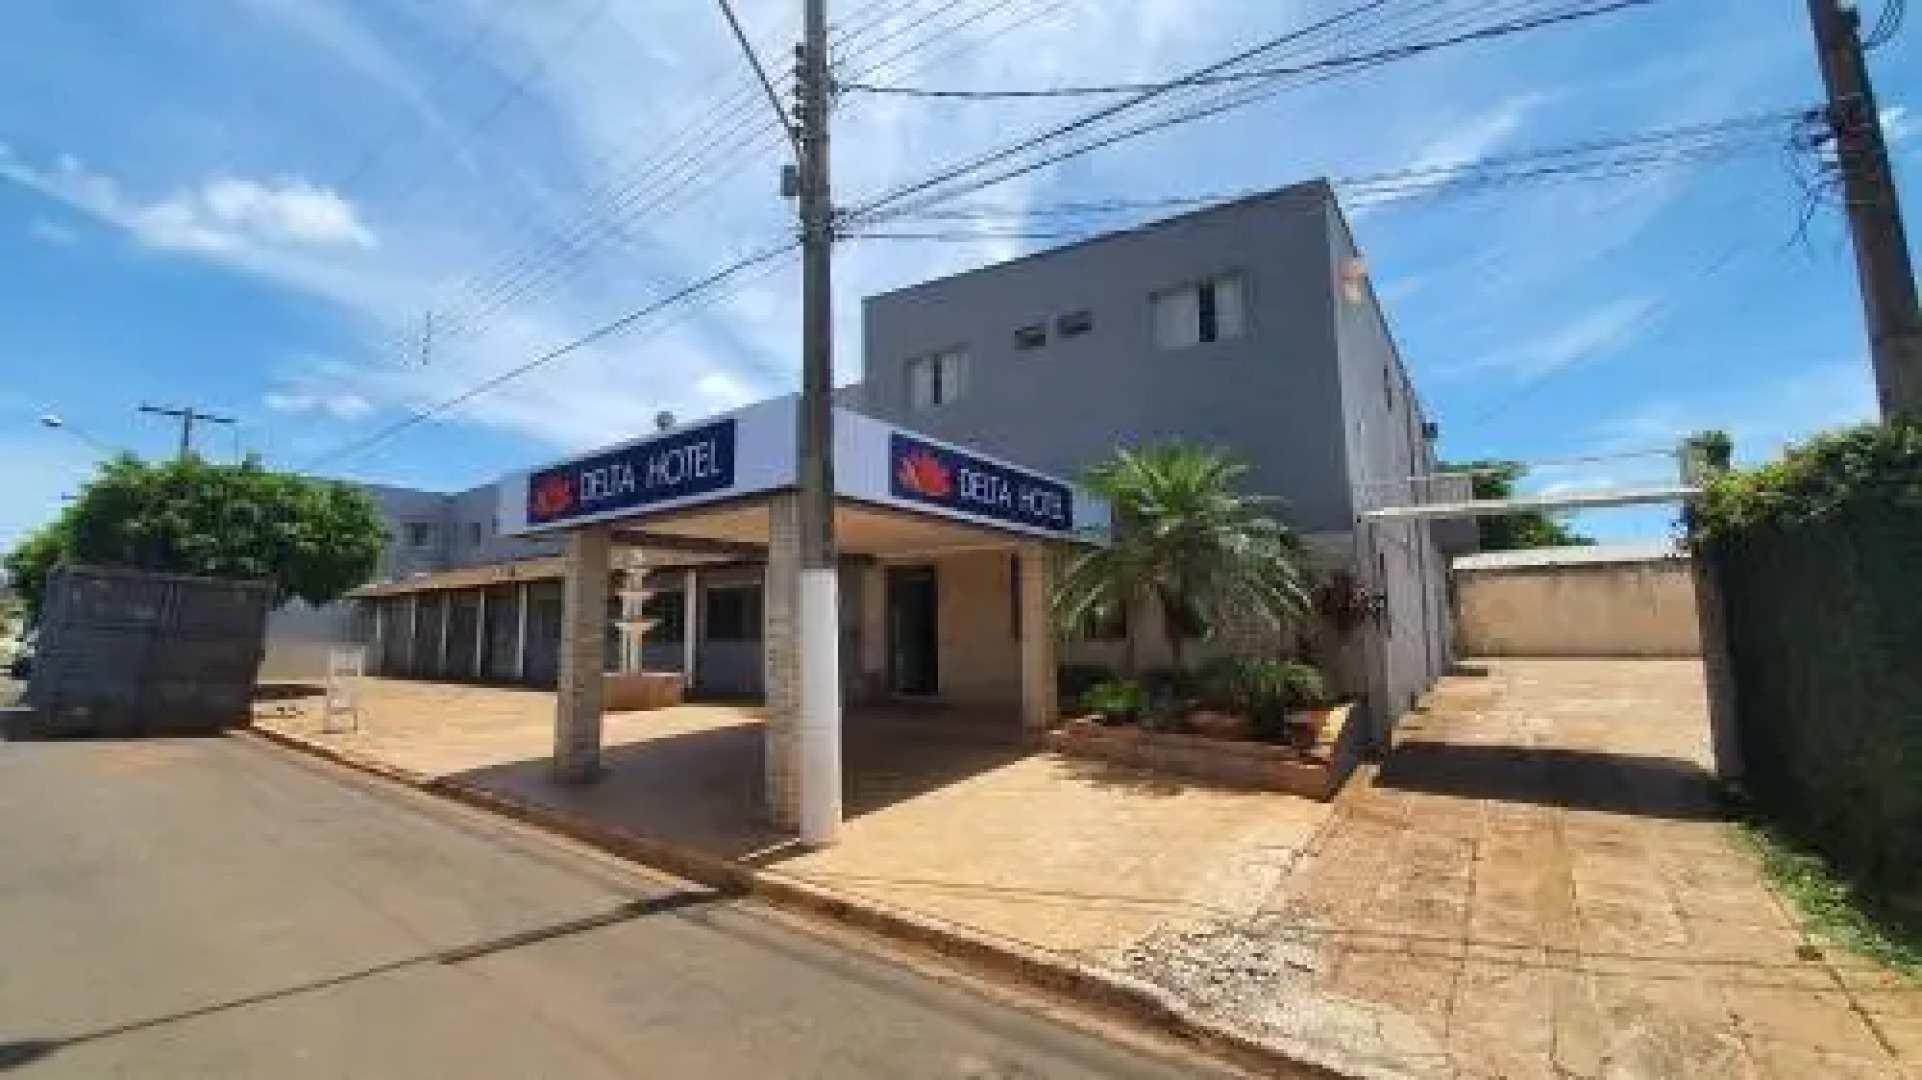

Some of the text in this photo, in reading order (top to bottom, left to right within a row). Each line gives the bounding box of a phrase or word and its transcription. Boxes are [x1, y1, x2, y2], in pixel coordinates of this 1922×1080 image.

[579, 439, 722, 502] DELTA HOTEL
[960, 468, 1066, 521] DELTA HOTEL
